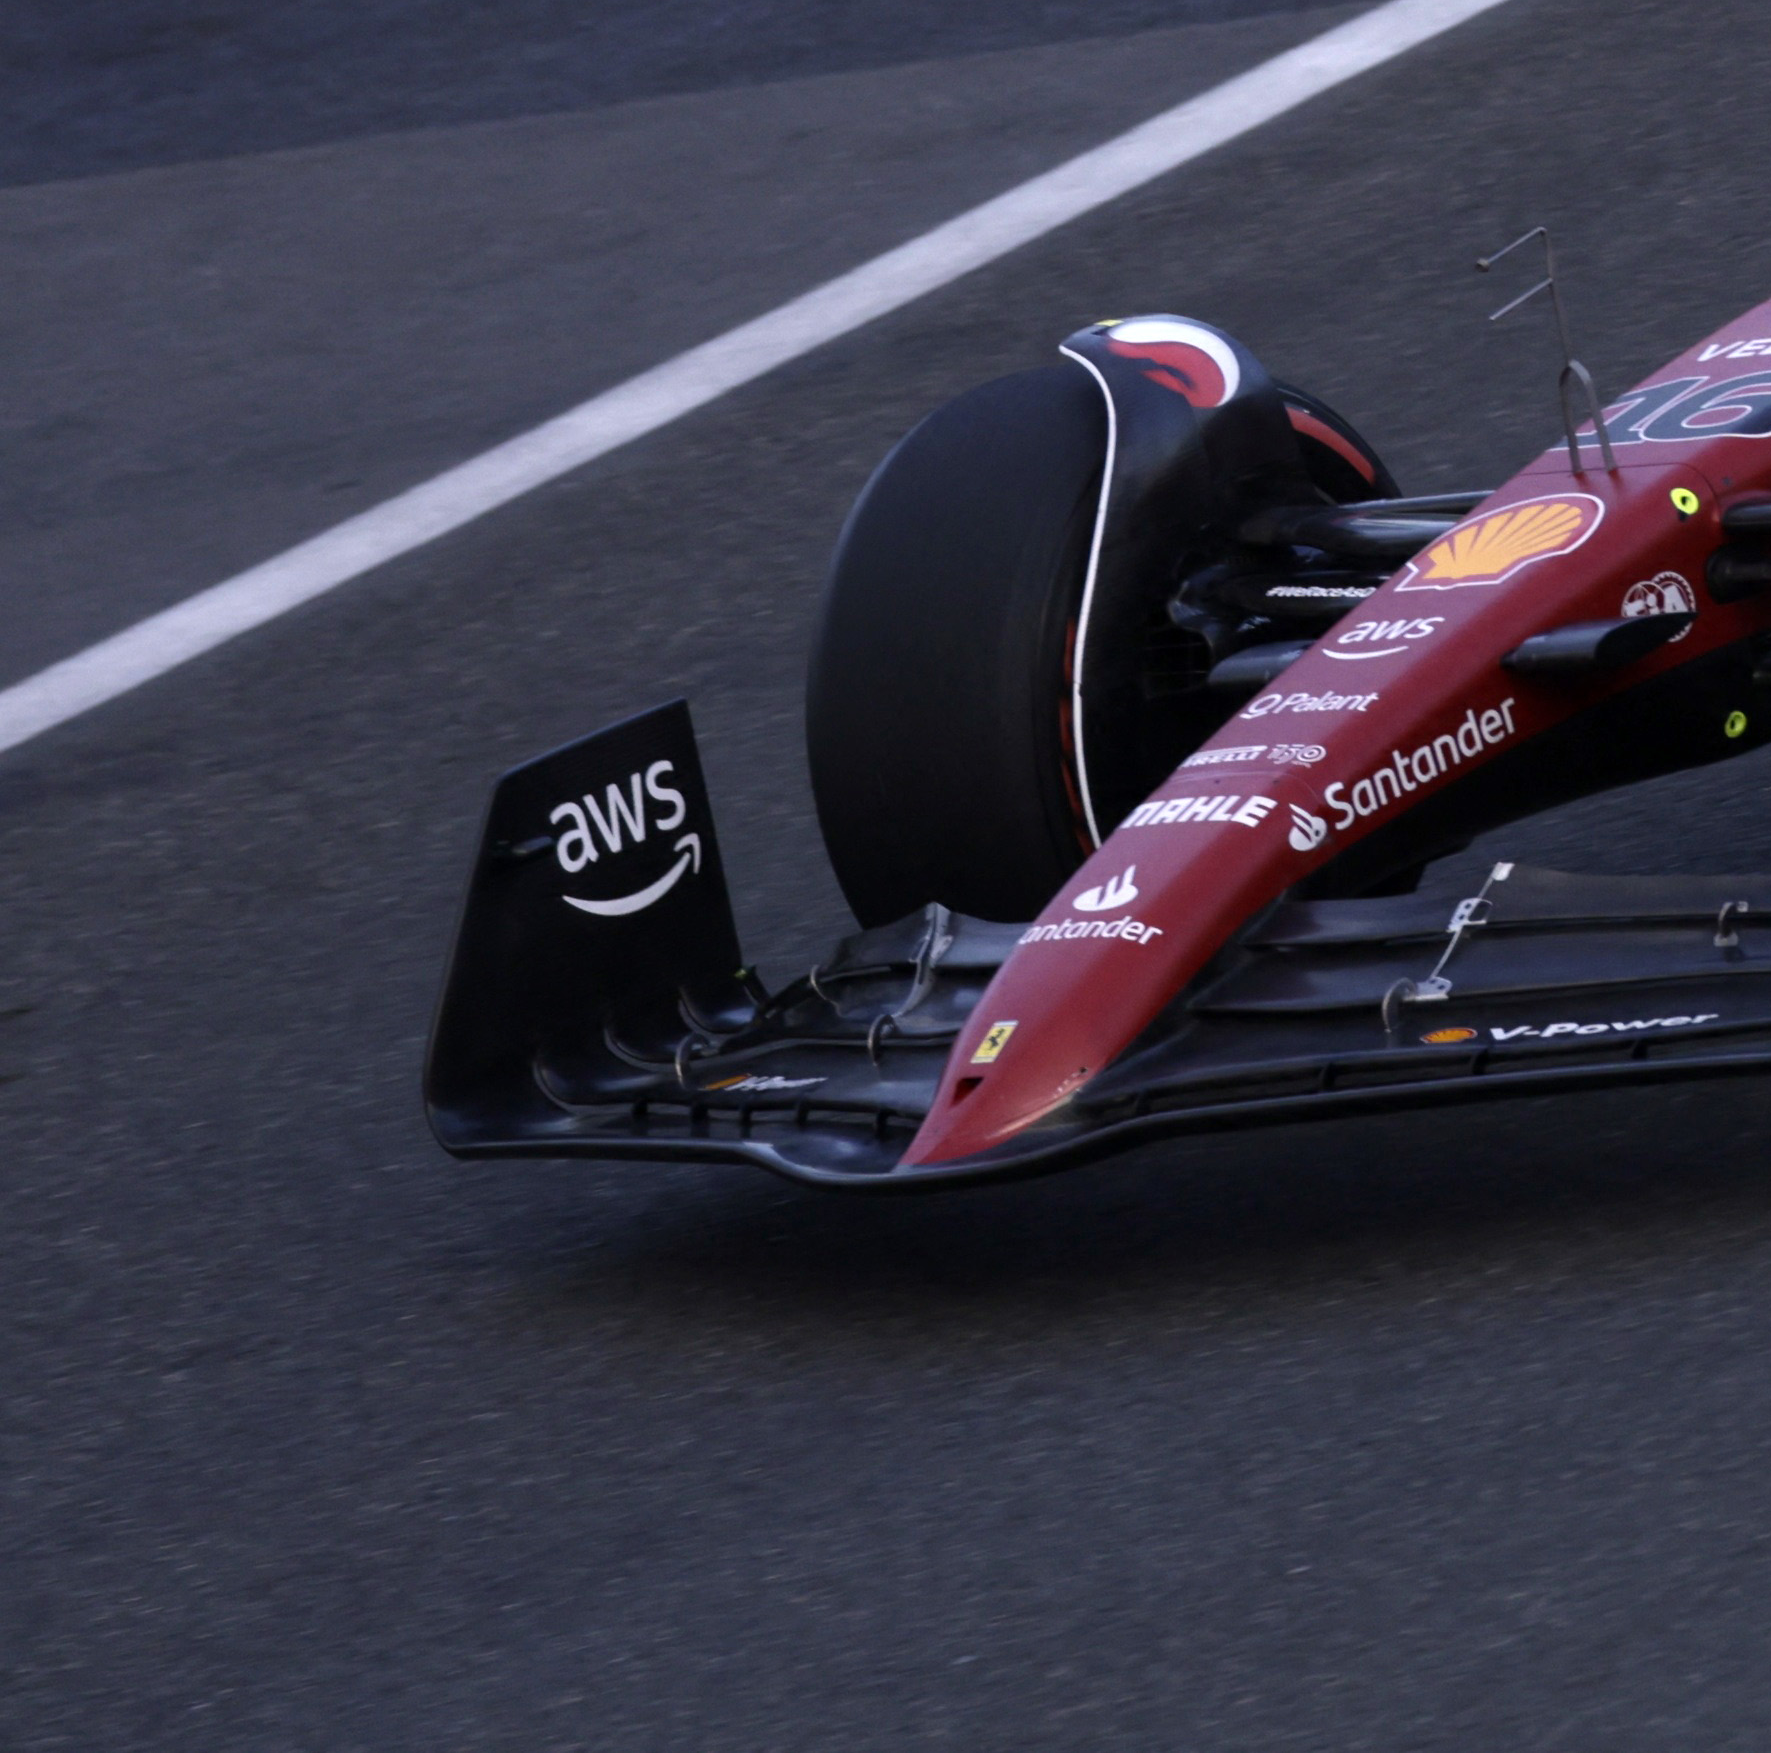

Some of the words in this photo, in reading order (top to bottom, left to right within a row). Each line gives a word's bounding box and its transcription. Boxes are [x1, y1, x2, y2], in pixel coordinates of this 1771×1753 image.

[1337, 616, 1445, 644] aws
[1324, 697, 1516, 831] Santander
[550, 759, 687, 873] aws
[1120, 795, 1279, 829] MAHLE
[1489, 1013, 1720, 1041] V-Power
